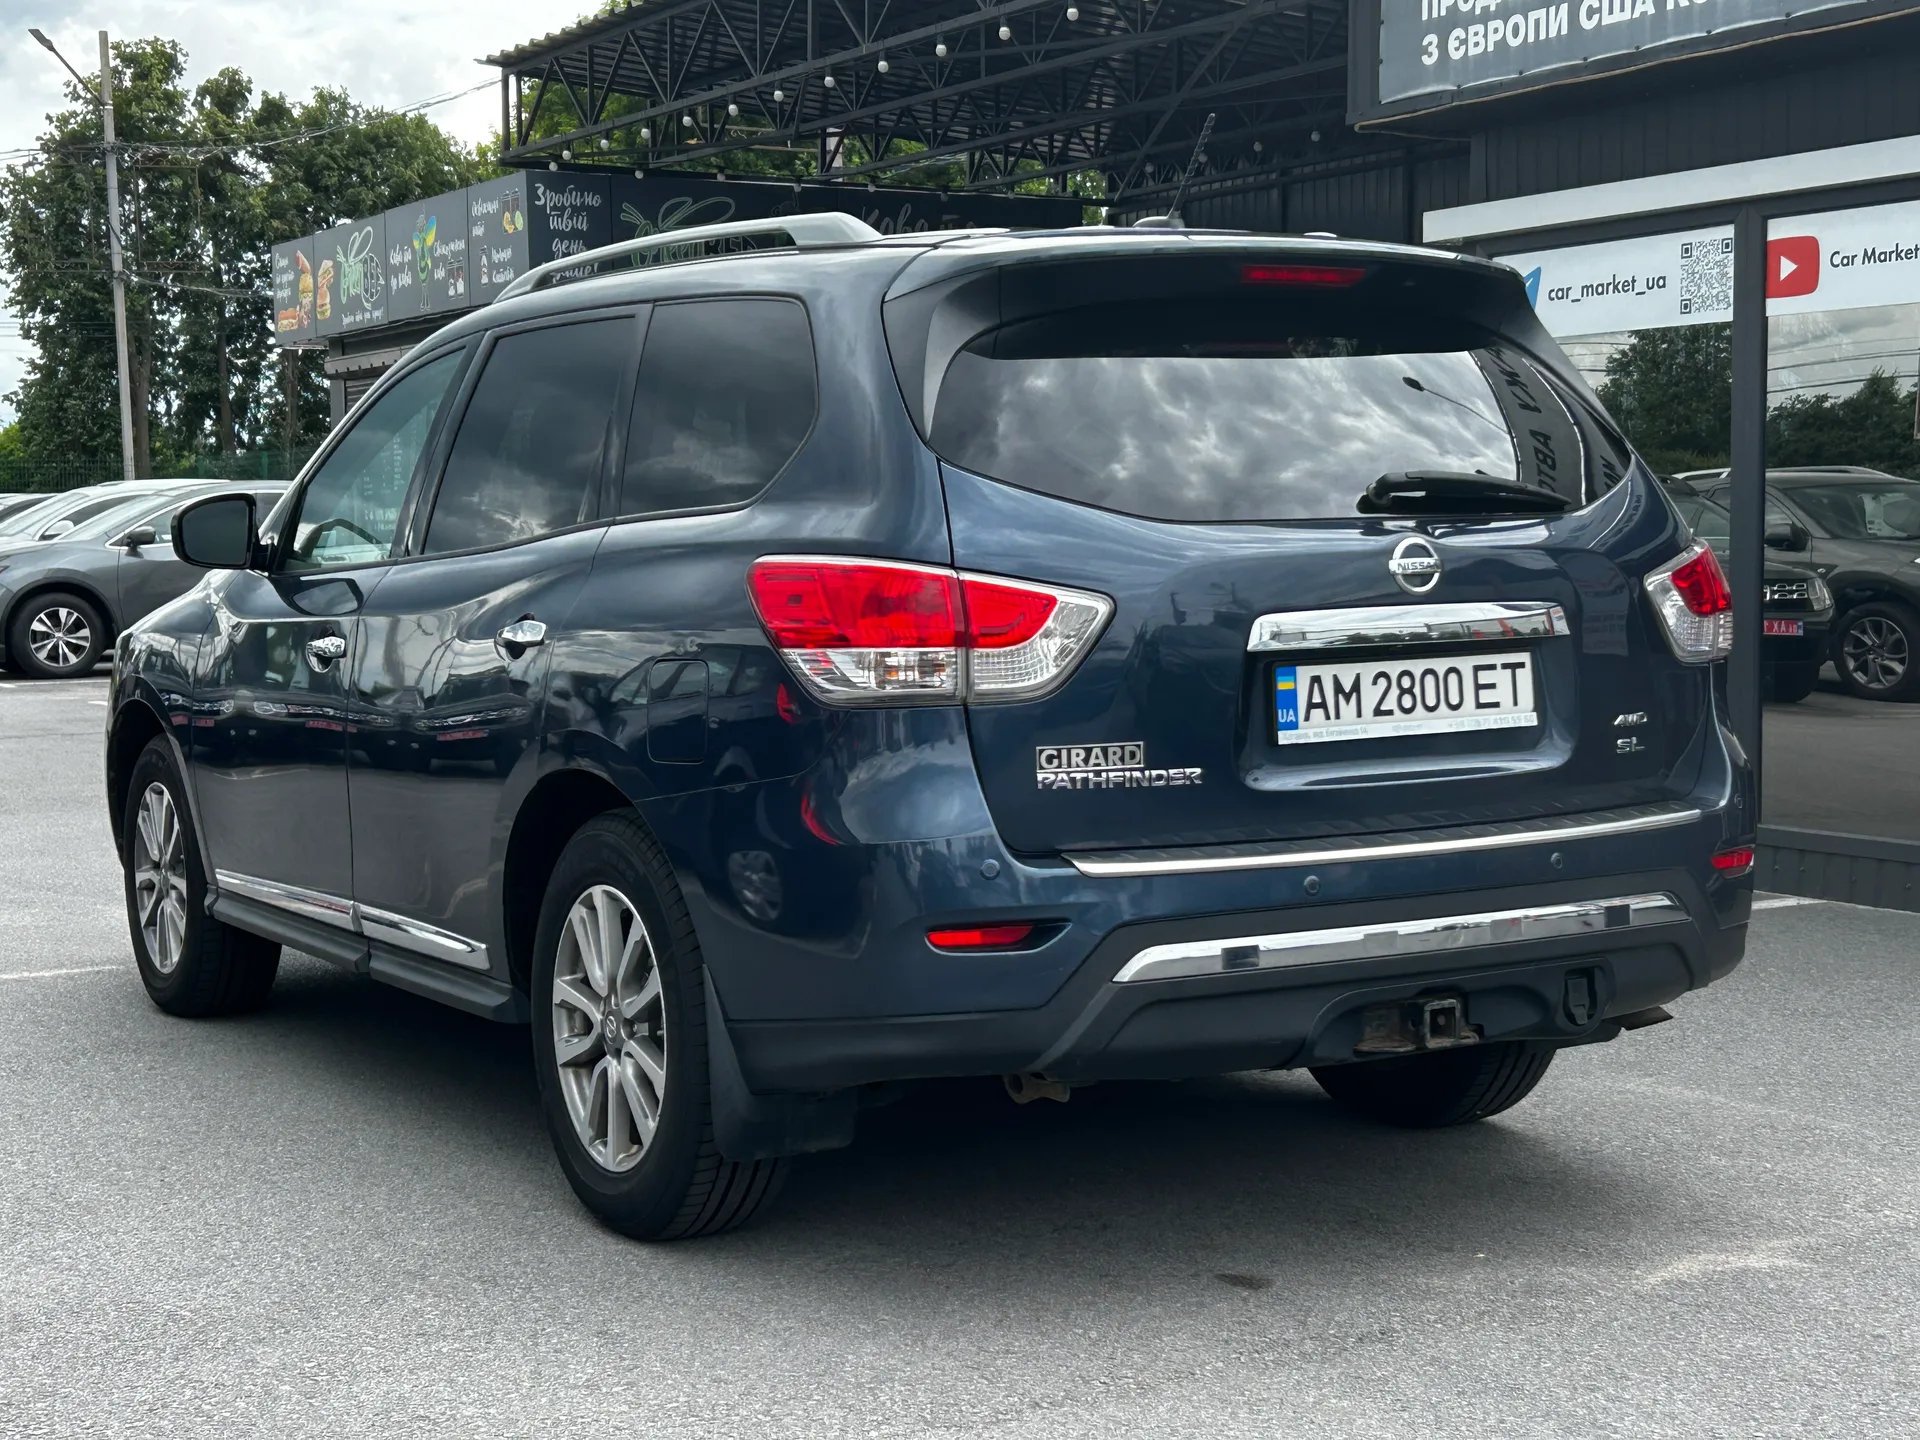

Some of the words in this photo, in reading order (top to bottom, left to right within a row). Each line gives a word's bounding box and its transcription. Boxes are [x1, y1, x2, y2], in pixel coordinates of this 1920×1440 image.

[1421, 33, 1439, 65] З
[1447, 2, 1568, 60] ЄВРОПИ
[1579, 0, 1655, 29] США
[1829, 250, 1858, 268] Car
[1861, 242, 1920, 265] Market
[1547, 273, 1667, 303] car_market_ua
[1303, 672, 1362, 722] AM
[1371, 666, 1464, 717] 2800
[1472, 661, 1526, 710] ET
[1277, 708, 1297, 723] UA
[1039, 745, 1141, 769] GIRARD
[1036, 767, 1203, 790] PATHFINDER
